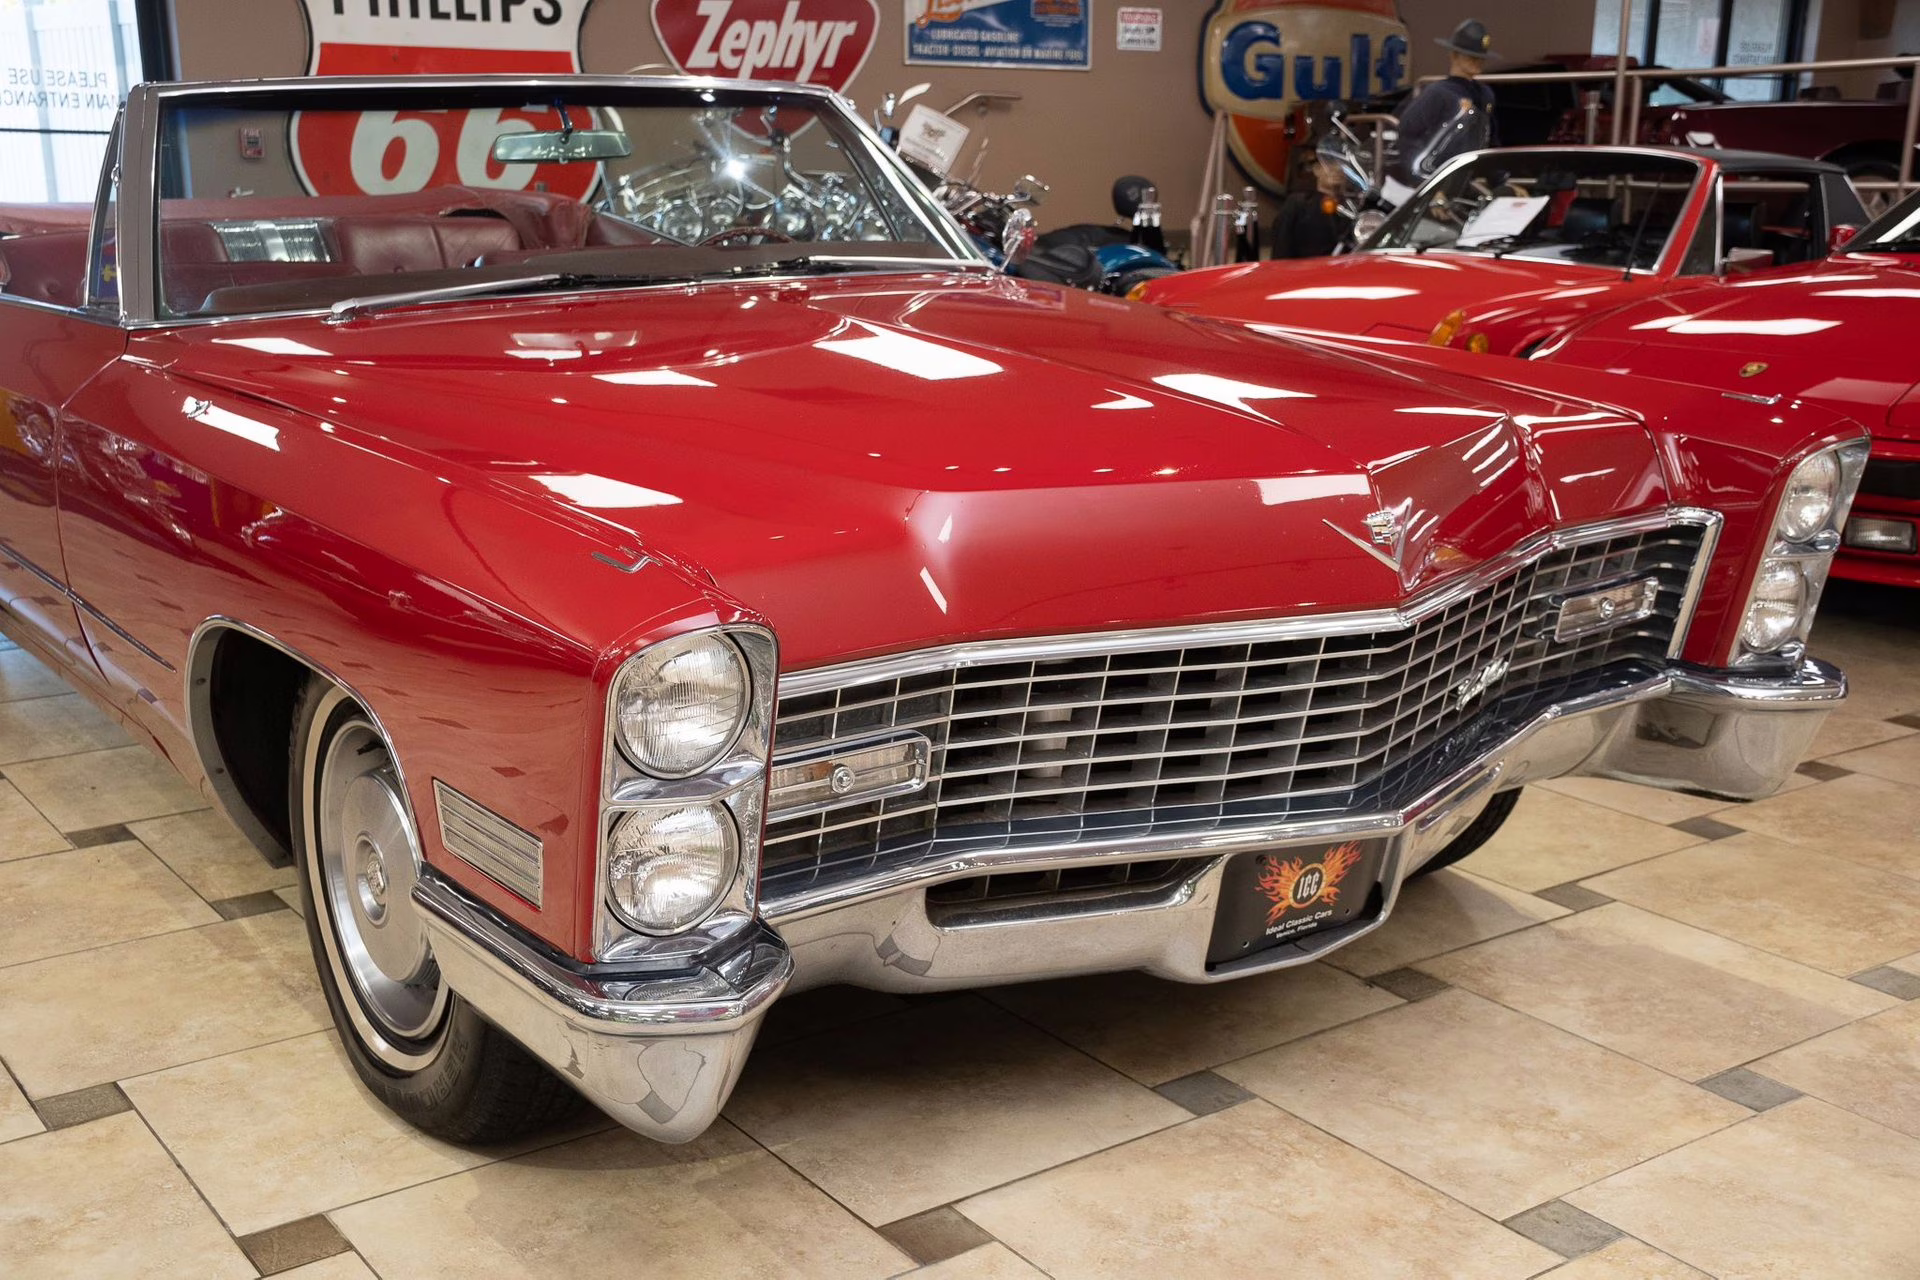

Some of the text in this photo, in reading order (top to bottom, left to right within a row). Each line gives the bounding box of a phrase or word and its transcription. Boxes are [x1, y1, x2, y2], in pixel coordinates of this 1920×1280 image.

[685, 0, 858, 83] Zephyr
[1221, 21, 1407, 101] Gulf
[351, 105, 539, 196] 66
[1265, 910, 1333, 935] Ideal Classic Cars
[1297, 871, 1320, 900] ICC
